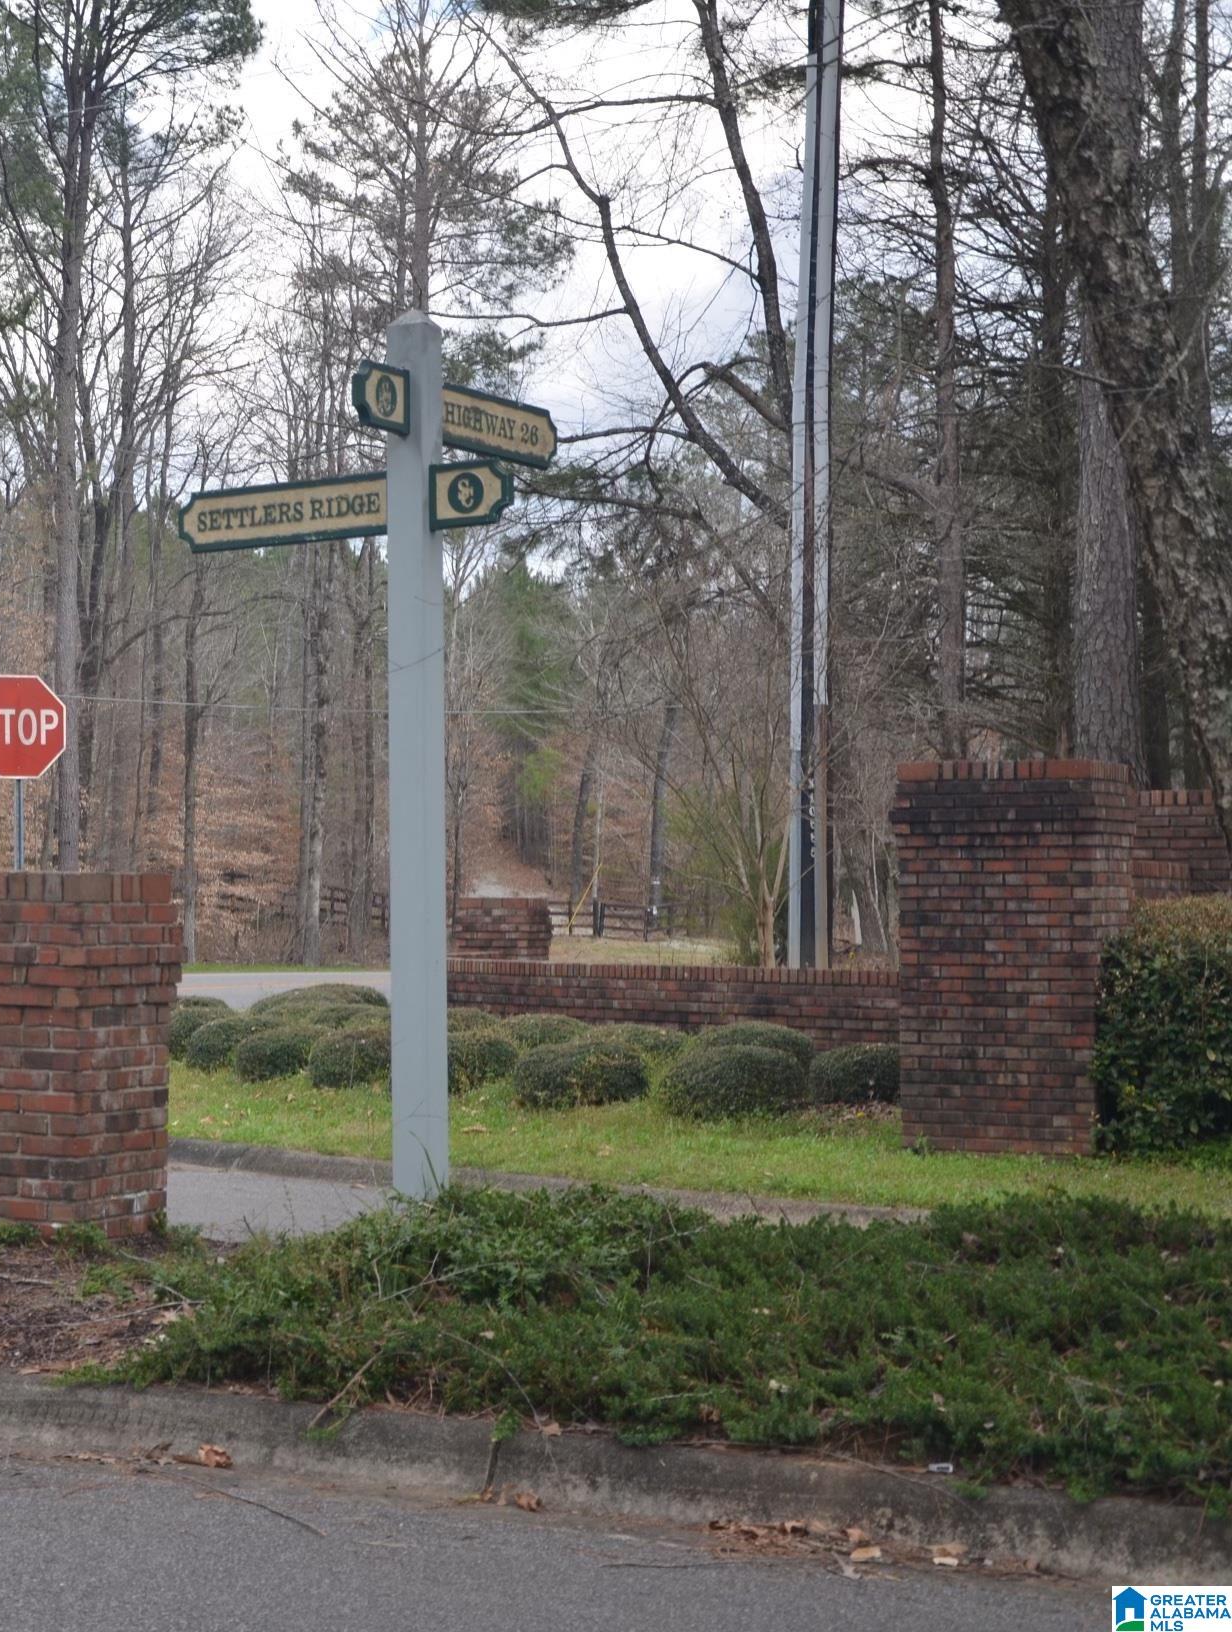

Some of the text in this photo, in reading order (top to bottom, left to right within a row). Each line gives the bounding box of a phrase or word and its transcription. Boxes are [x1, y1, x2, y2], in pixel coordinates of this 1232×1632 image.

[444, 402, 516, 440] HIGHWAY
[197, 492, 380, 533] SETTLERS RIDGE
